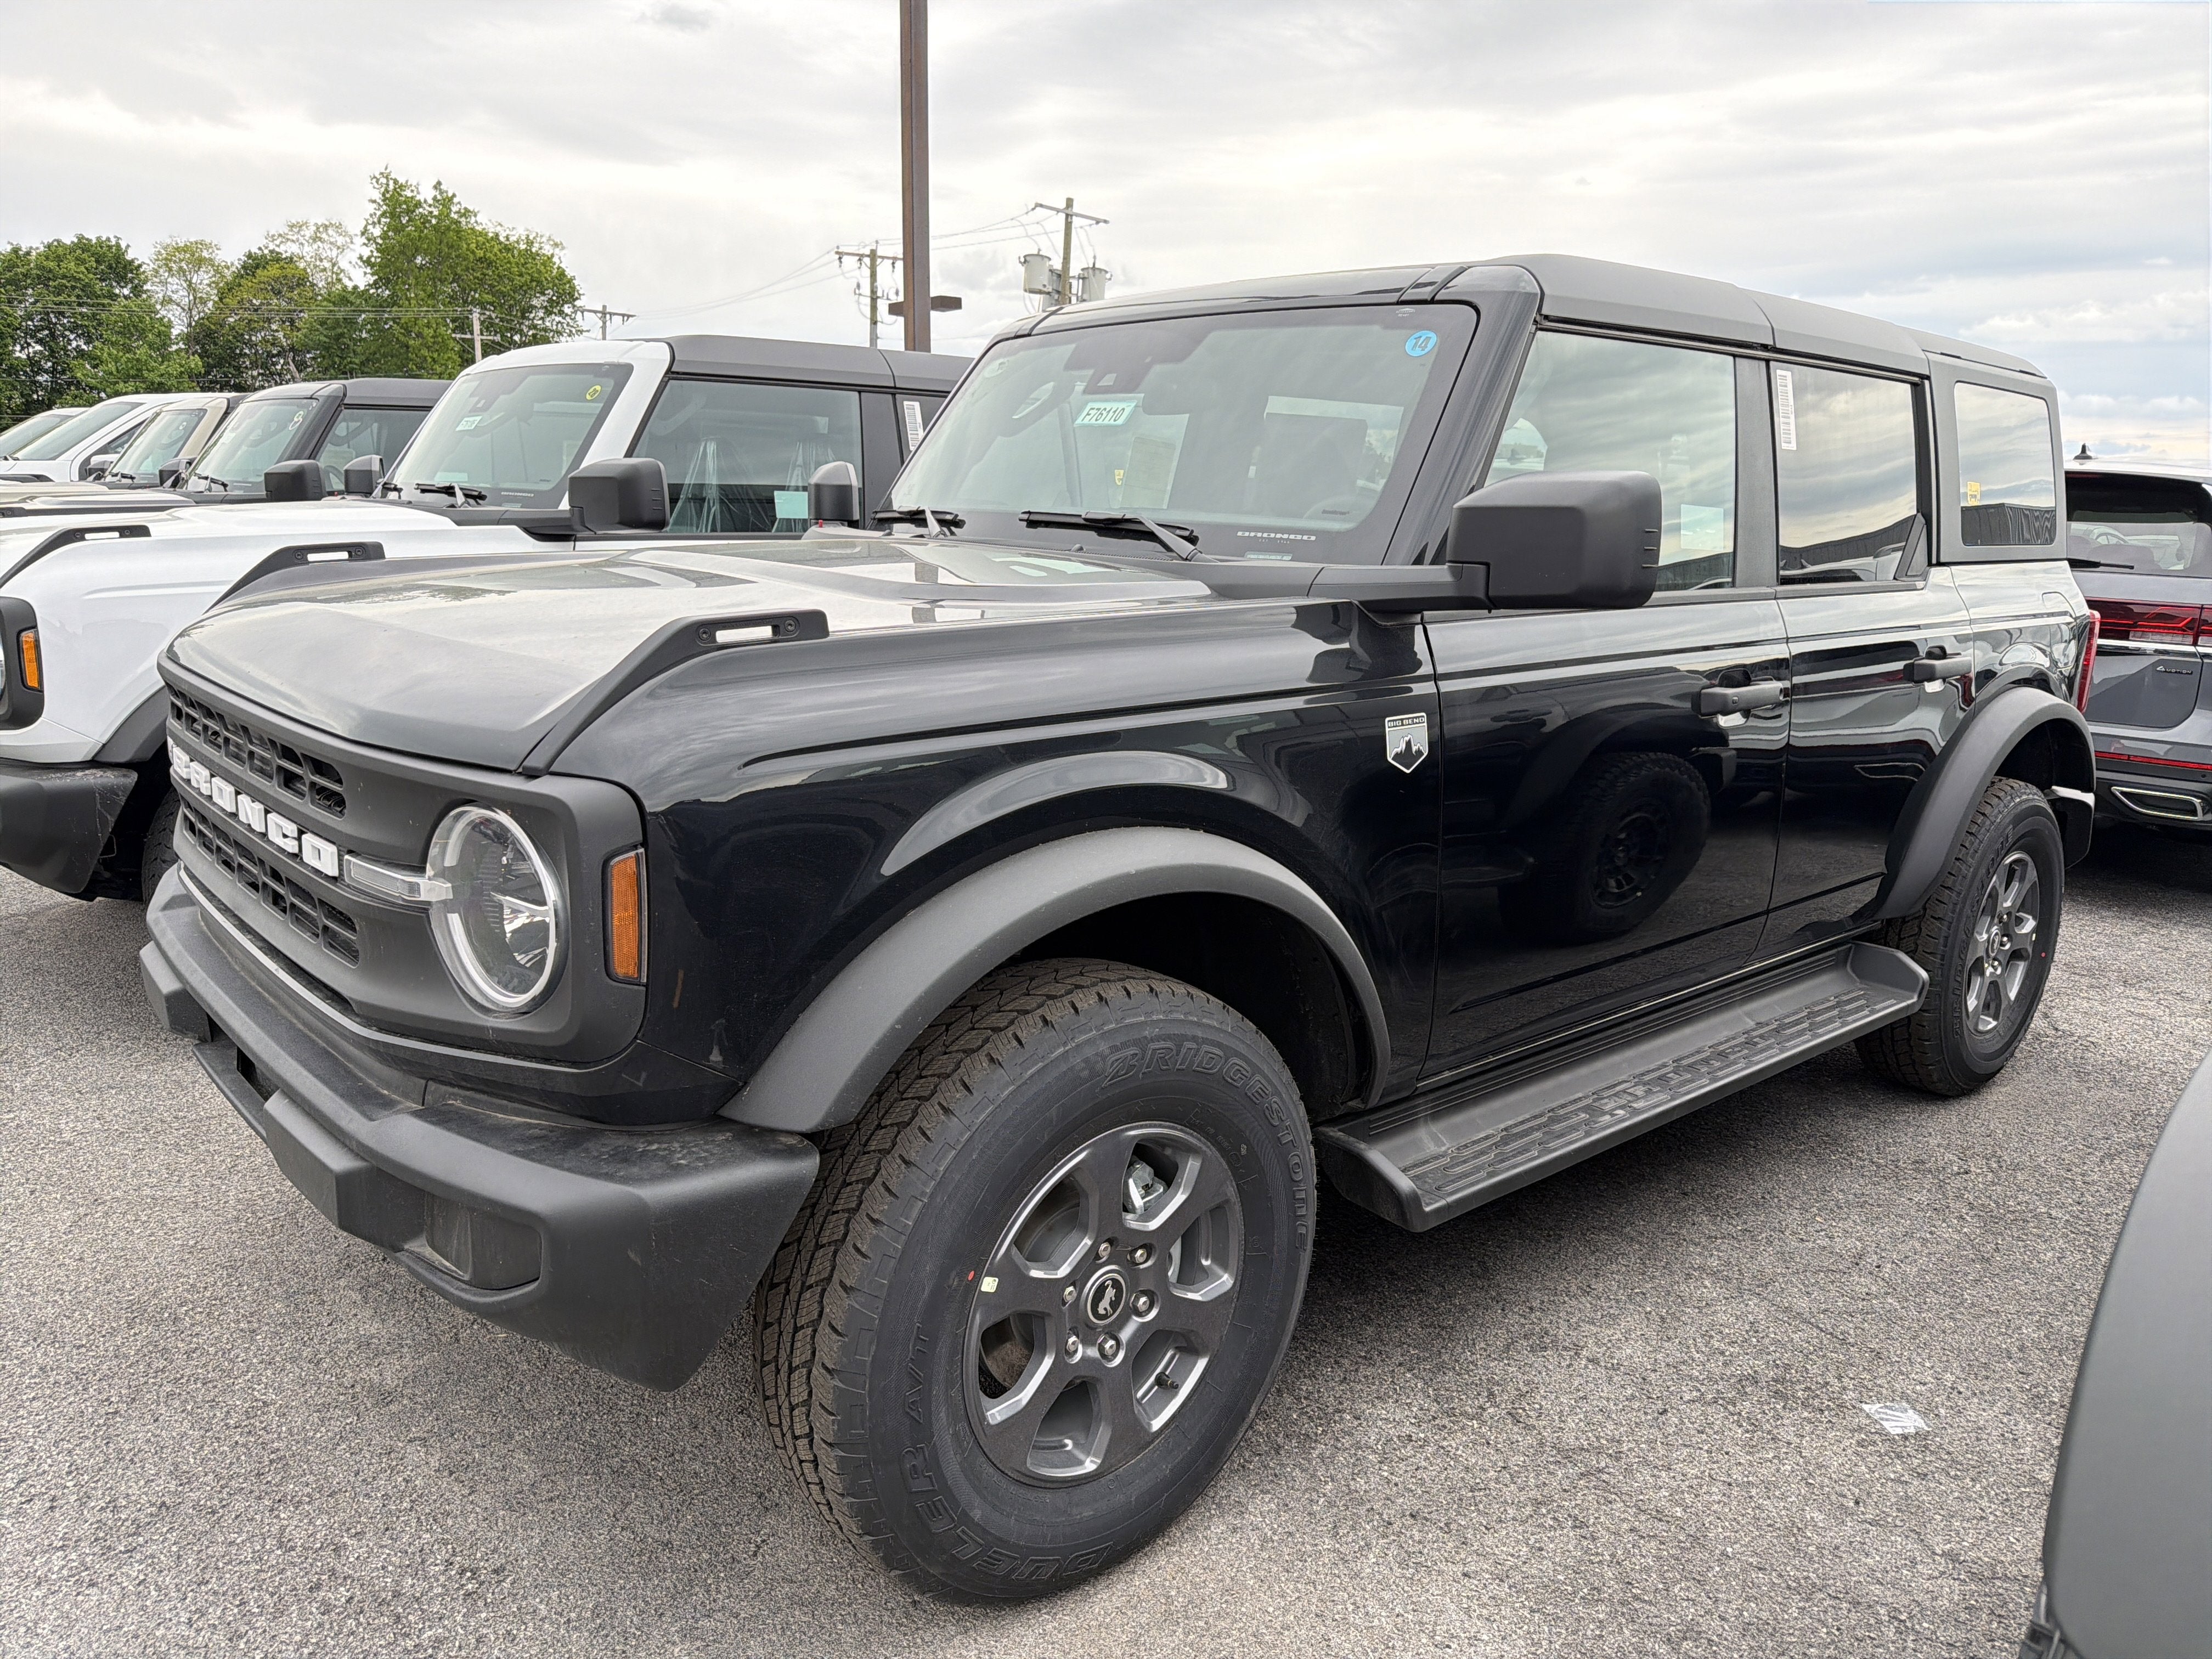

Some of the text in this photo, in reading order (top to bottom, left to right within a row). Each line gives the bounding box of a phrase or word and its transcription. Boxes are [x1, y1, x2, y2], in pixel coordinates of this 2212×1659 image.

[1411, 335, 1432, 352] 14
[1081, 407, 1126, 422] F76110
[1237, 531, 1316, 541] BRONCO
[2156, 665, 2192, 674] 4MOTION
[173, 747, 340, 877] BRONCO
[1101, 1041, 1308, 1250] BRIDGESTONE
[904, 1322, 930, 1423] A/T
[899, 1444, 1115, 1581] DUELER
